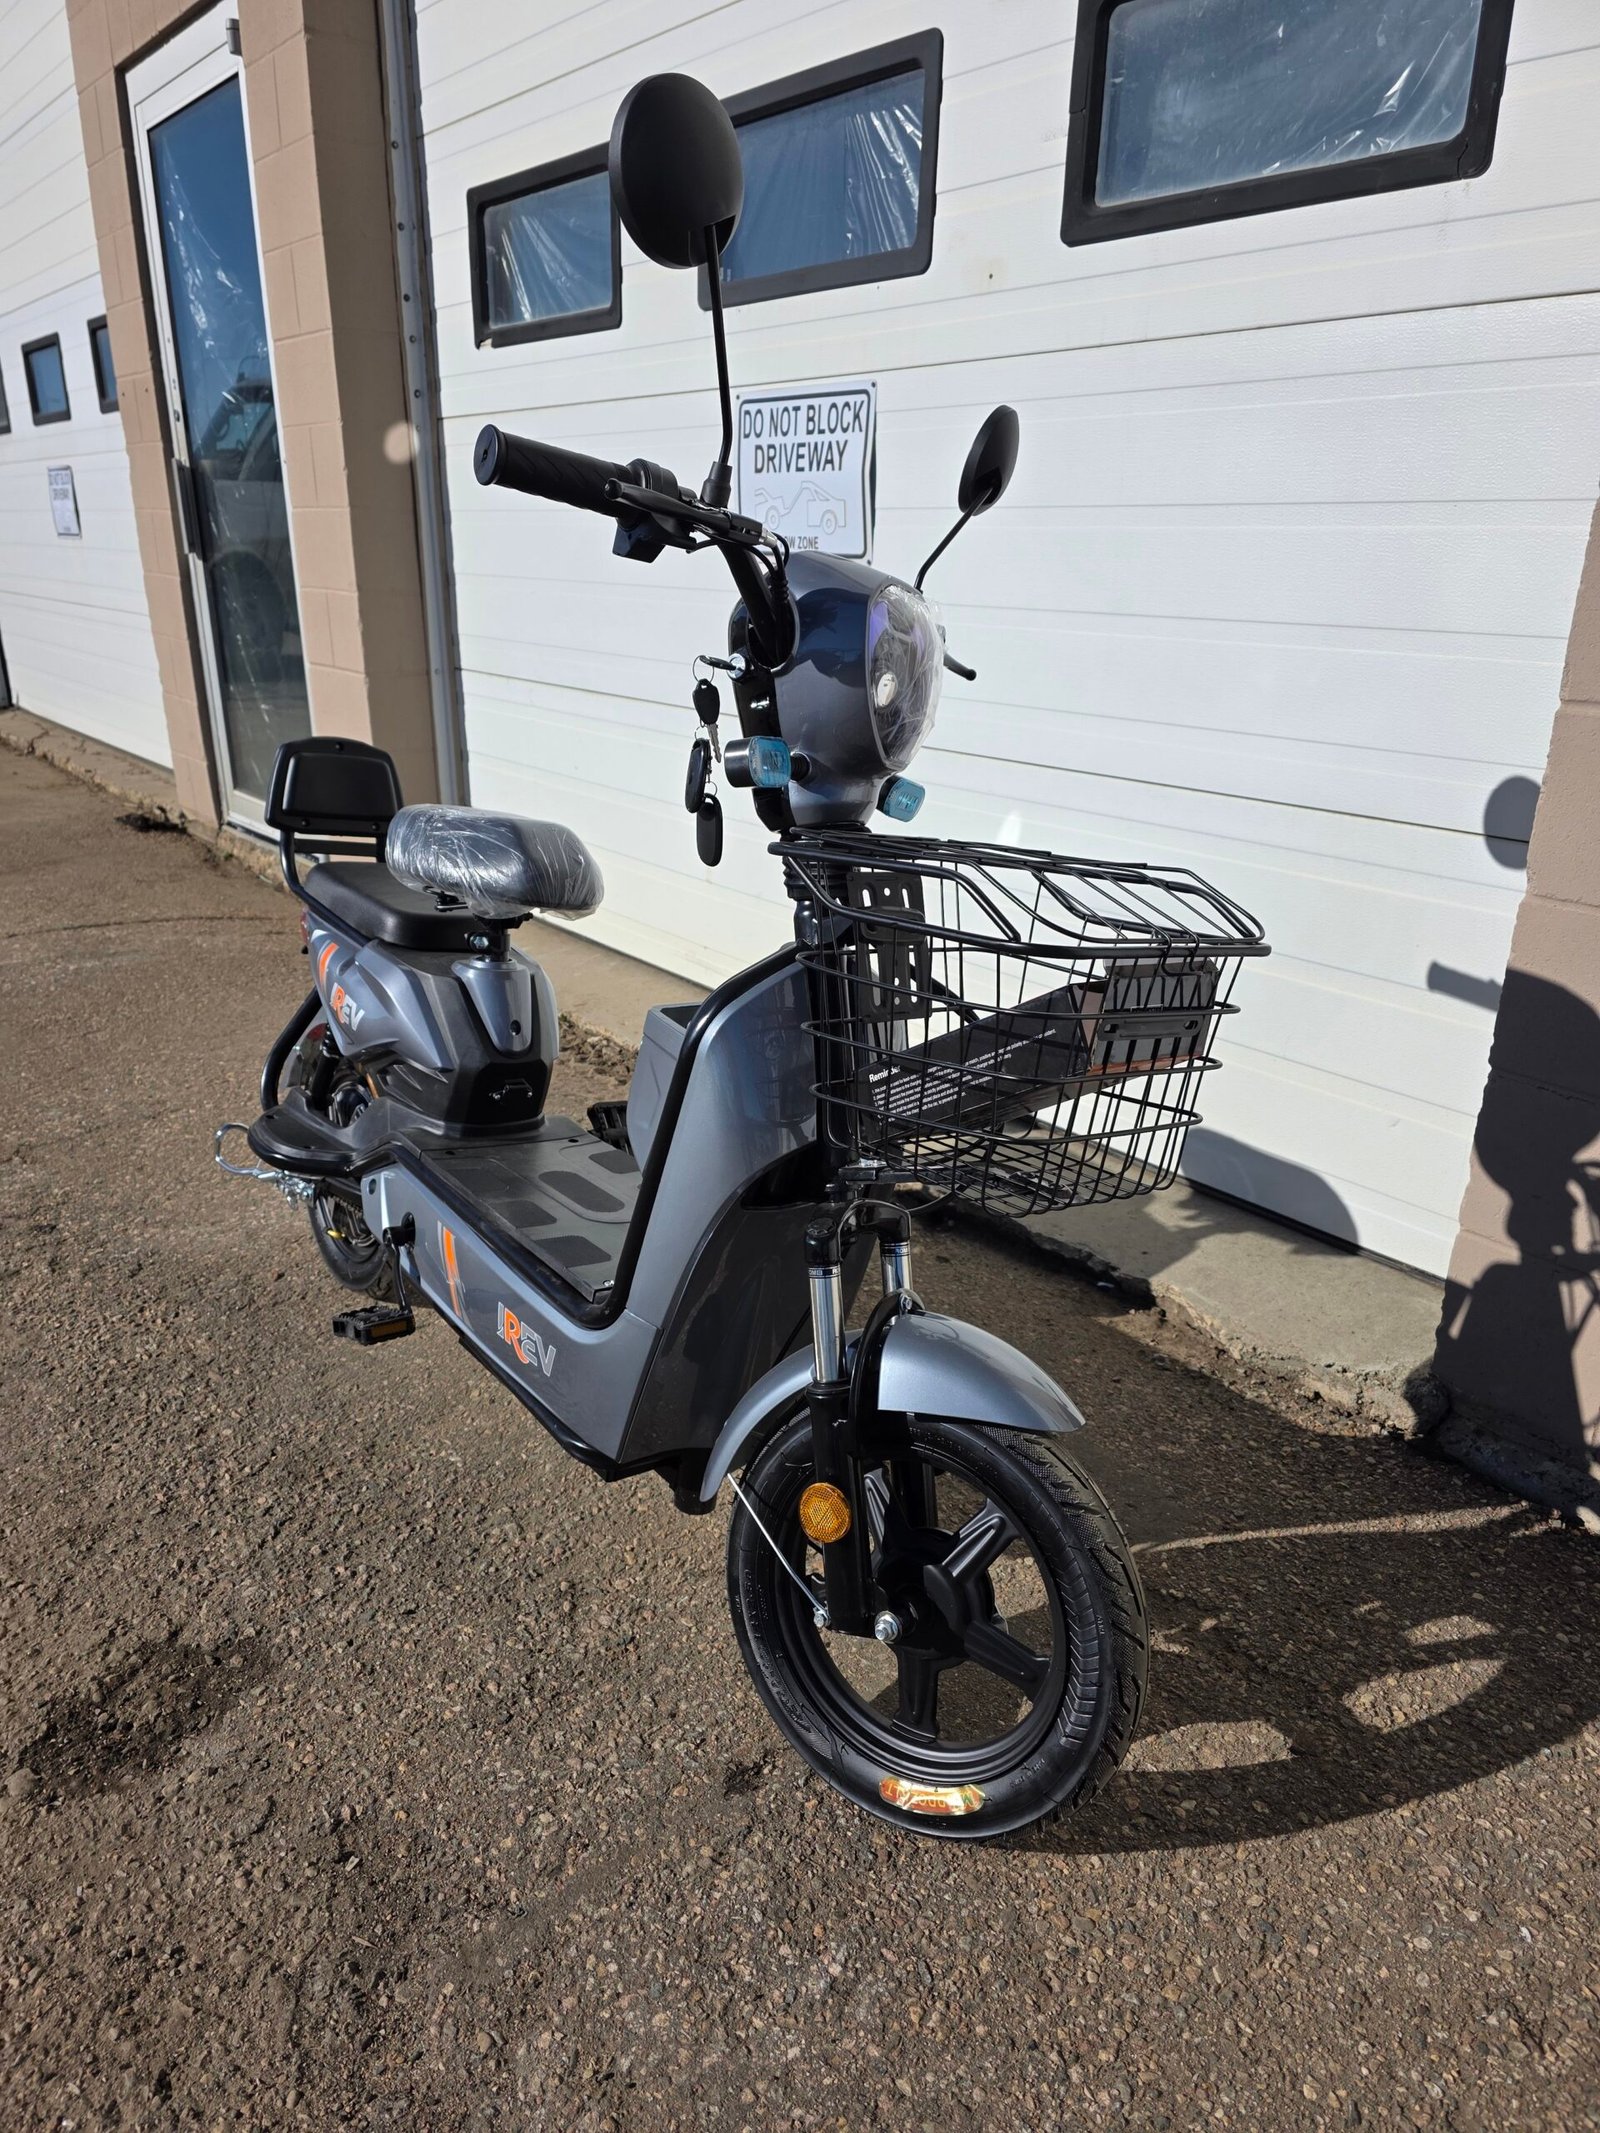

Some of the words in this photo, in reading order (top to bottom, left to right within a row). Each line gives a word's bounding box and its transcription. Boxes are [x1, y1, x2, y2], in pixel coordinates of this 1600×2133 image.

[743, 408, 764, 438] DO
[769, 405, 801, 437] NOT
[806, 400, 864, 435] BLOCK
[754, 440, 848, 474] DRIVEWAY
[797, 536, 819, 549] ZONE
